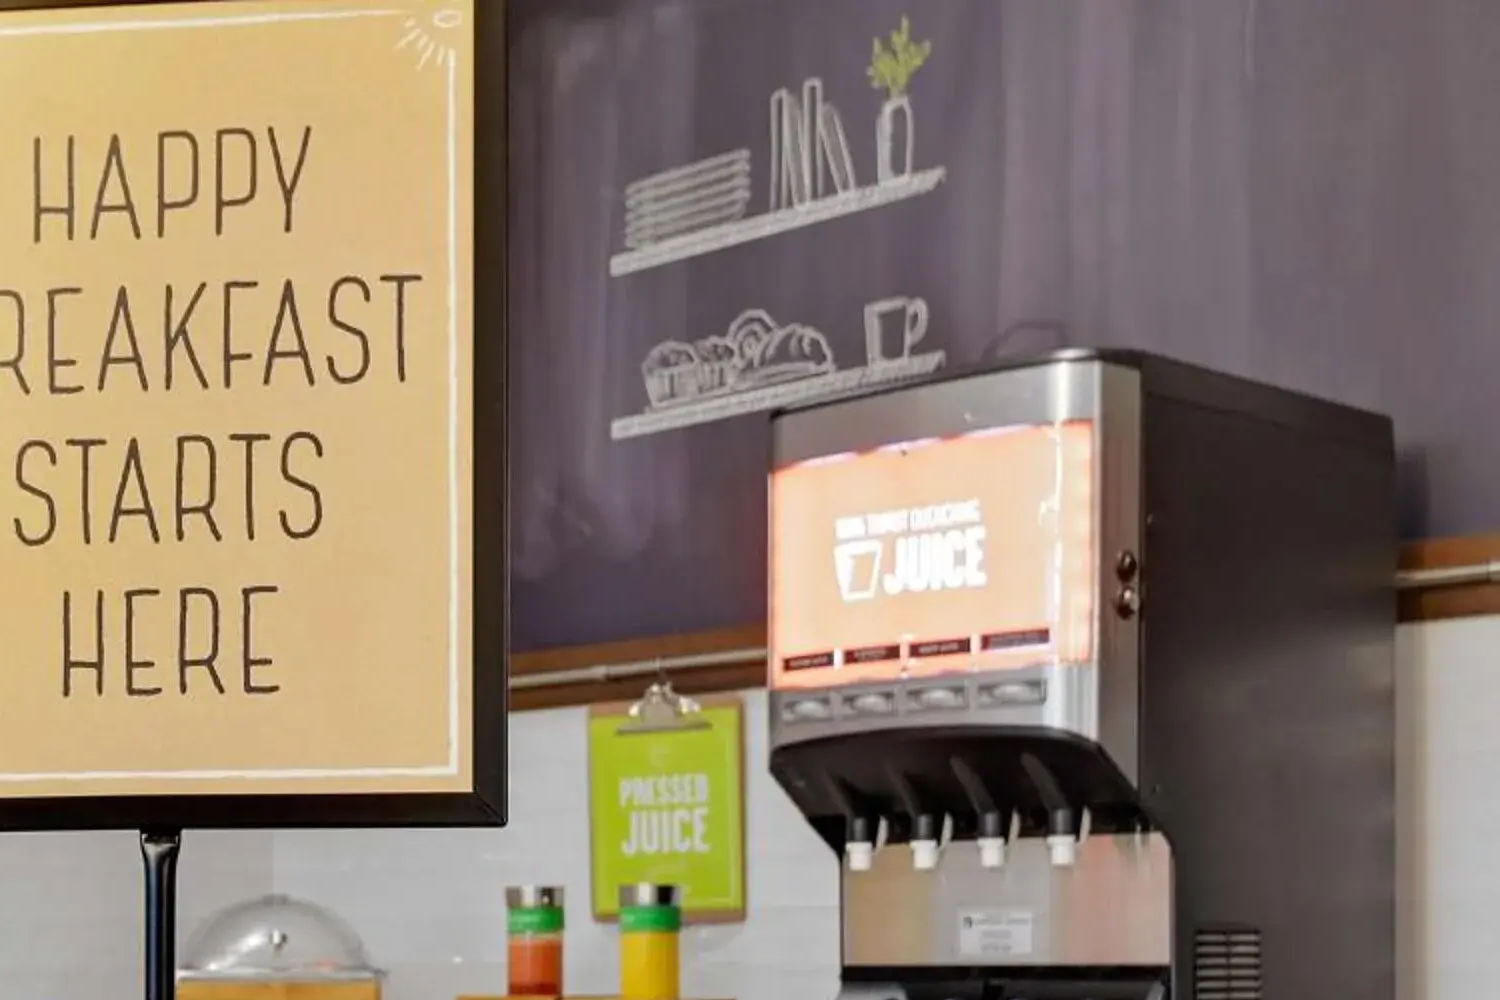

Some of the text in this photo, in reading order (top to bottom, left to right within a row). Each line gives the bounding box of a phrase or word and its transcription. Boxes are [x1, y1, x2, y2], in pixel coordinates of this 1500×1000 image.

[32, 125, 311, 243] HAPPY
[13, 431, 324, 546] STARTS
[882, 525, 987, 594] JUICE
[62, 585, 280, 698] HERE
[619, 773, 709, 807] PRESSED
[621, 807, 710, 857] JUICE
